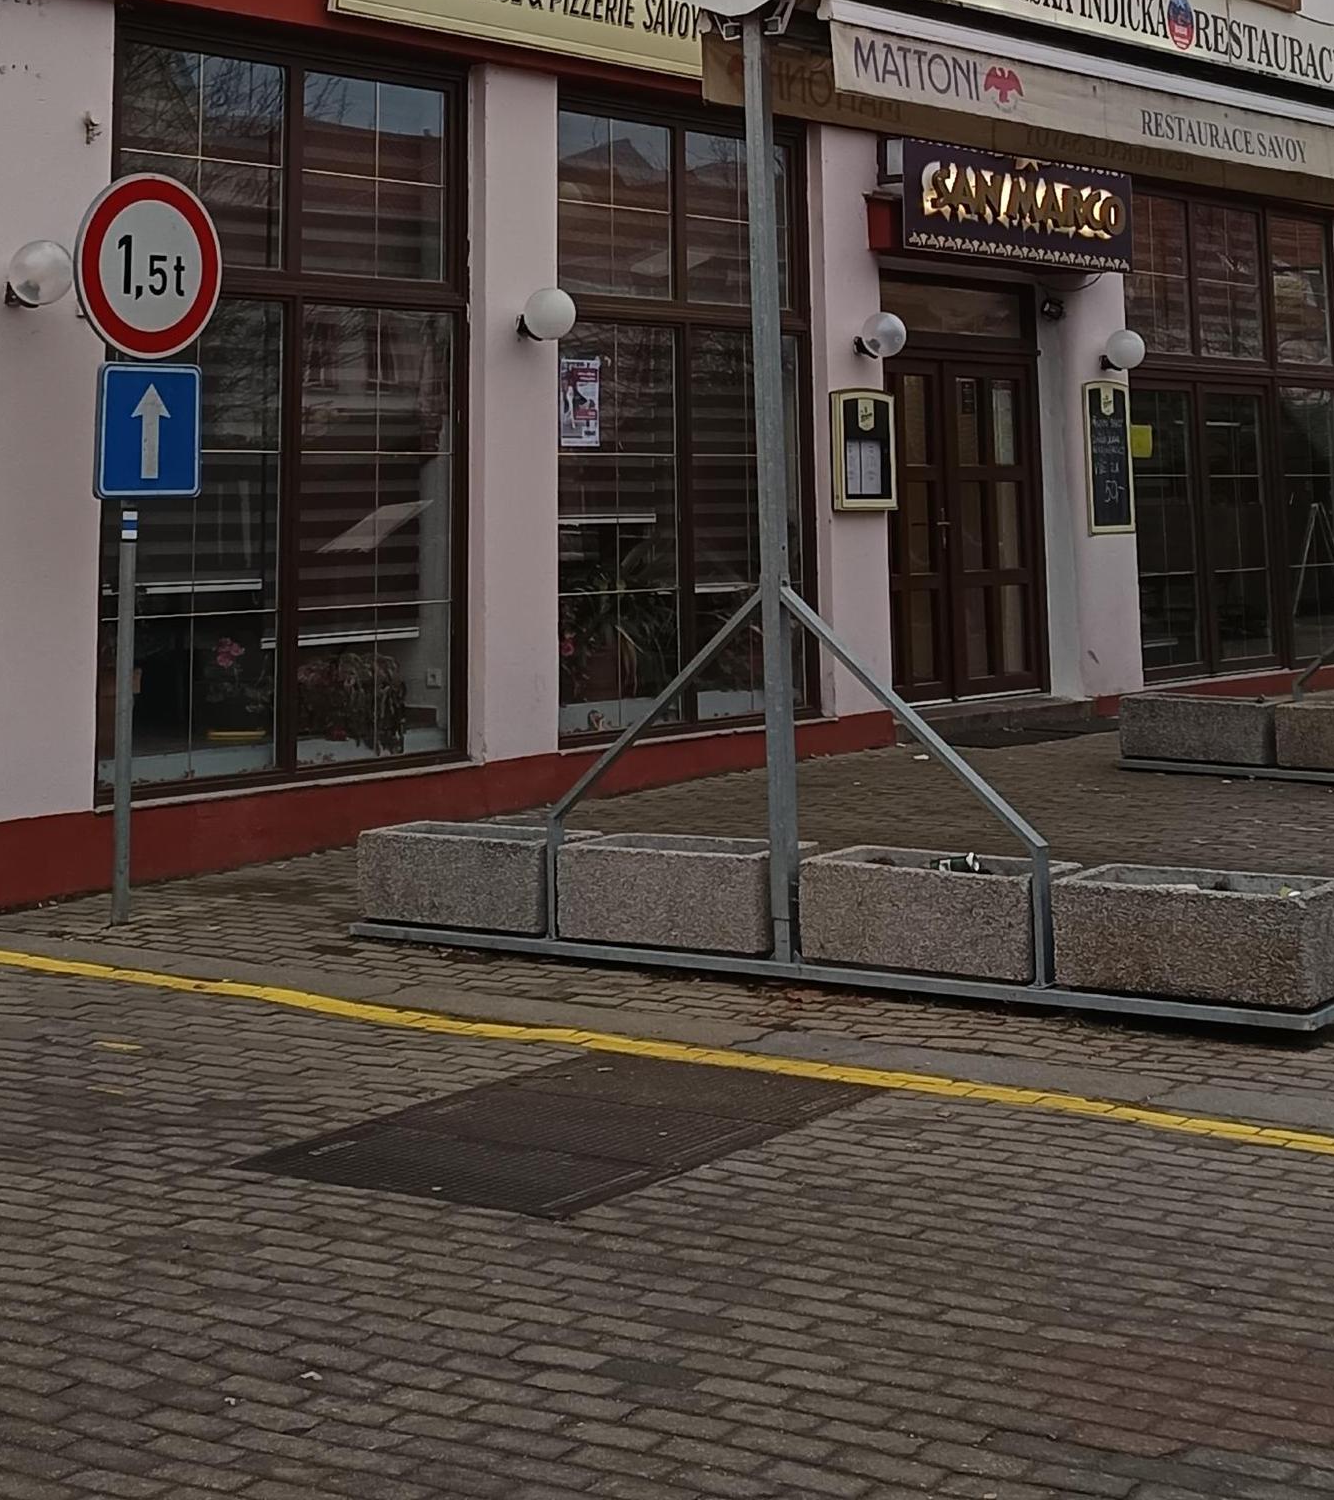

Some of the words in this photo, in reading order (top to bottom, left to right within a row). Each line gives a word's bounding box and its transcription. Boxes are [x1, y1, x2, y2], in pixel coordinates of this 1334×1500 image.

[853, 36, 981, 101] MATTONI
[1140, 109, 1255, 156] RESTAURACE
[1256, 132, 1307, 165] SAVOY
[930, 164, 1003, 220] SAN
[1006, 176, 1127, 237] MARCO
